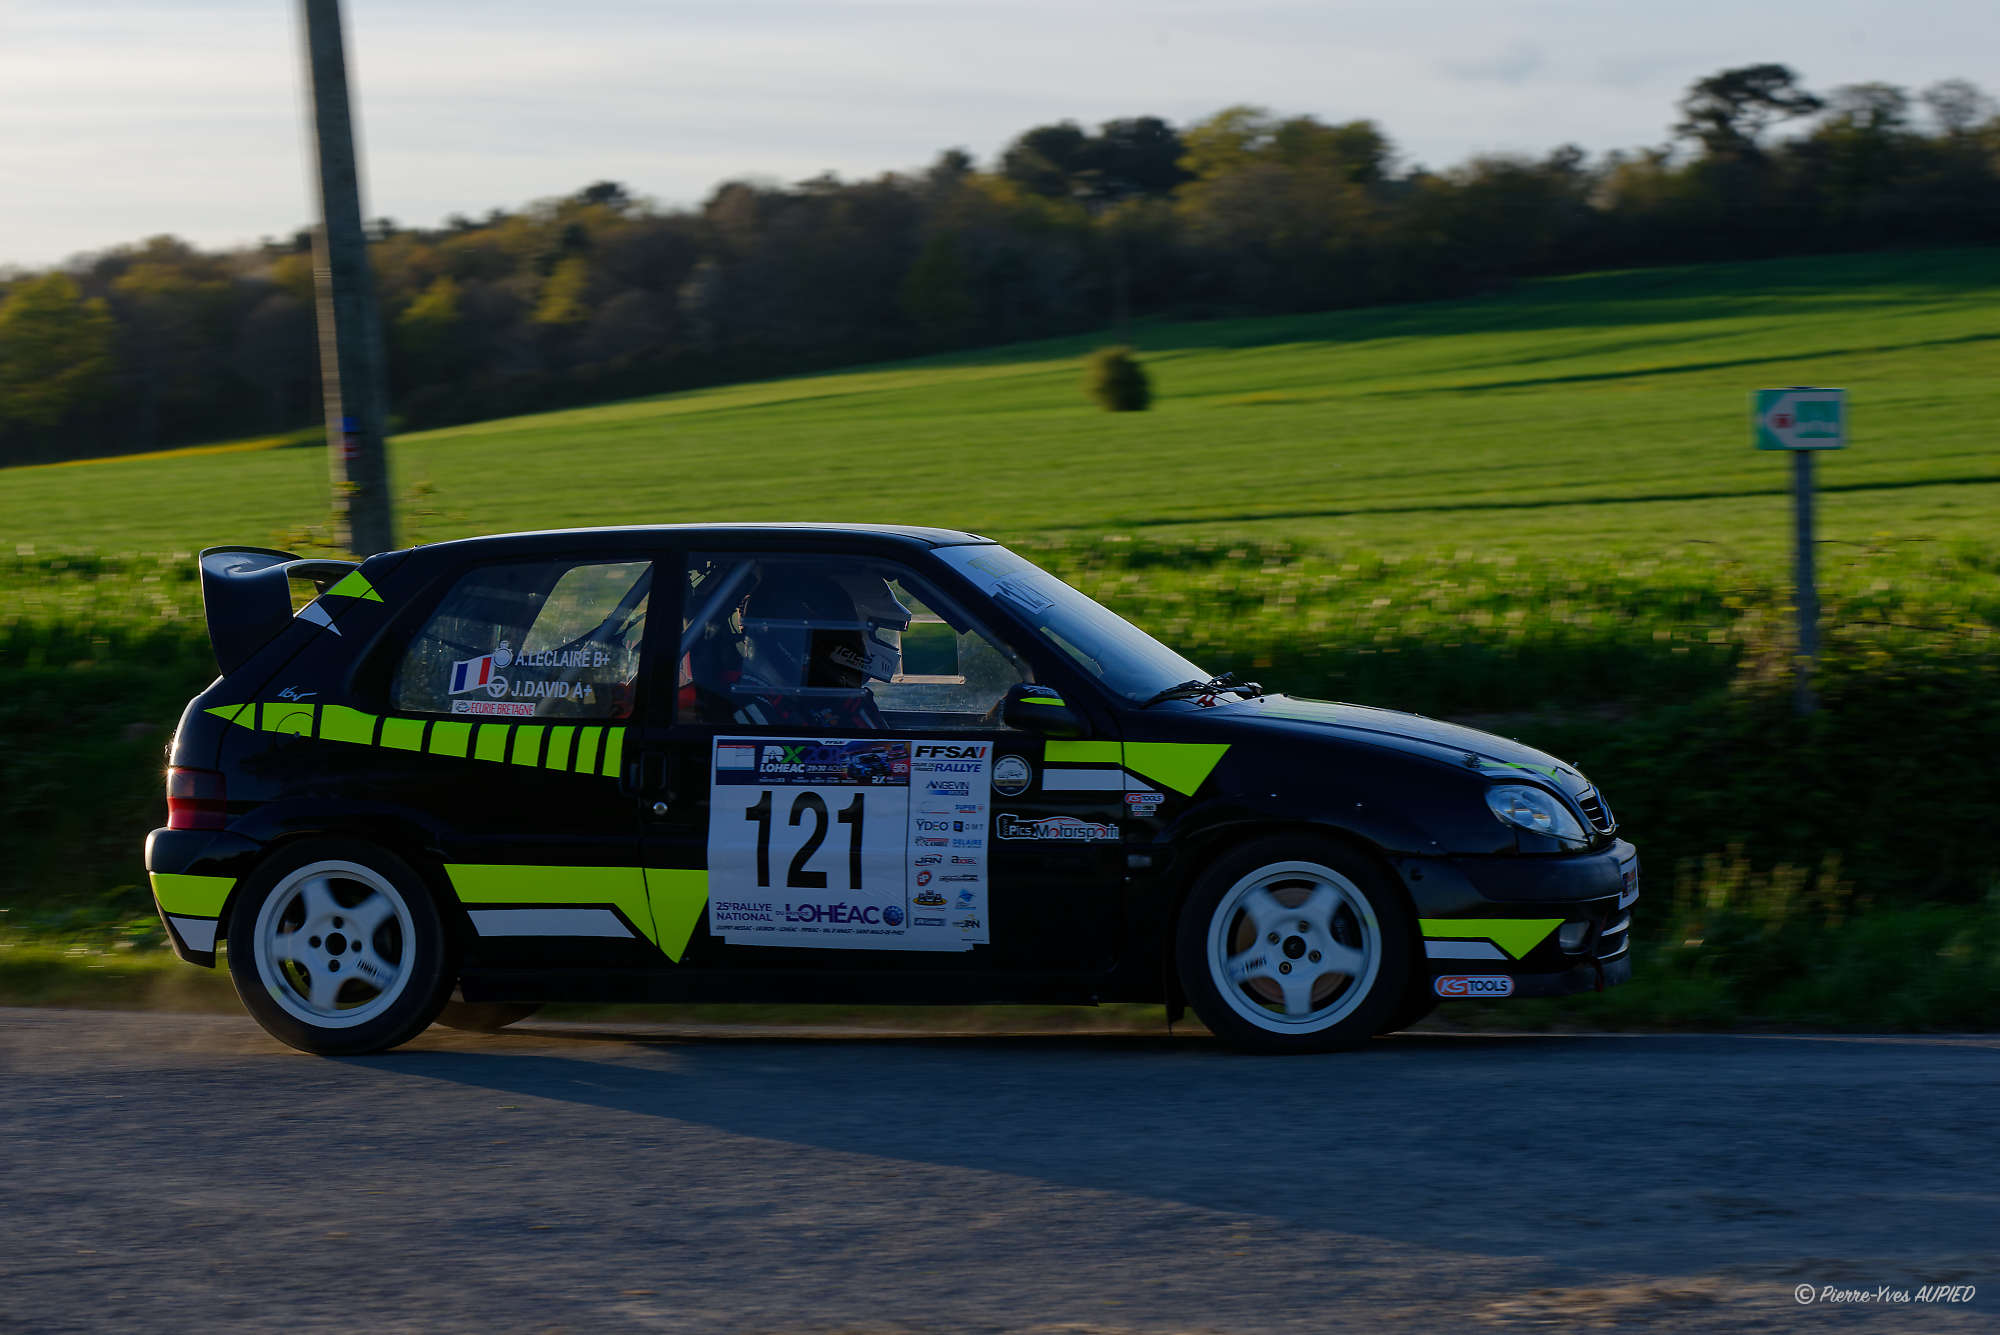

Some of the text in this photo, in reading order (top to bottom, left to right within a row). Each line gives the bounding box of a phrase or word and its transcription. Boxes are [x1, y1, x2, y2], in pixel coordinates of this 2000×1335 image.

[514, 650, 611, 668] A.LECLAIRE B+
[511, 681, 593, 698] J.DAVID A+
[470, 702, 536, 715] ECURIE BRETAGNE
[915, 746, 979, 758] FFSA
[759, 763, 806, 773] LOHEAC
[934, 763, 982, 773] RALLYE
[1008, 825, 1033, 836] Pics
[745, 790, 865, 890] 121
[732, 902, 772, 912] RALLYE
[785, 902, 880, 924] LOHÉAC
[716, 912, 773, 922] NATIONAL
[1440, 980, 1507, 993] KS TOOLS
